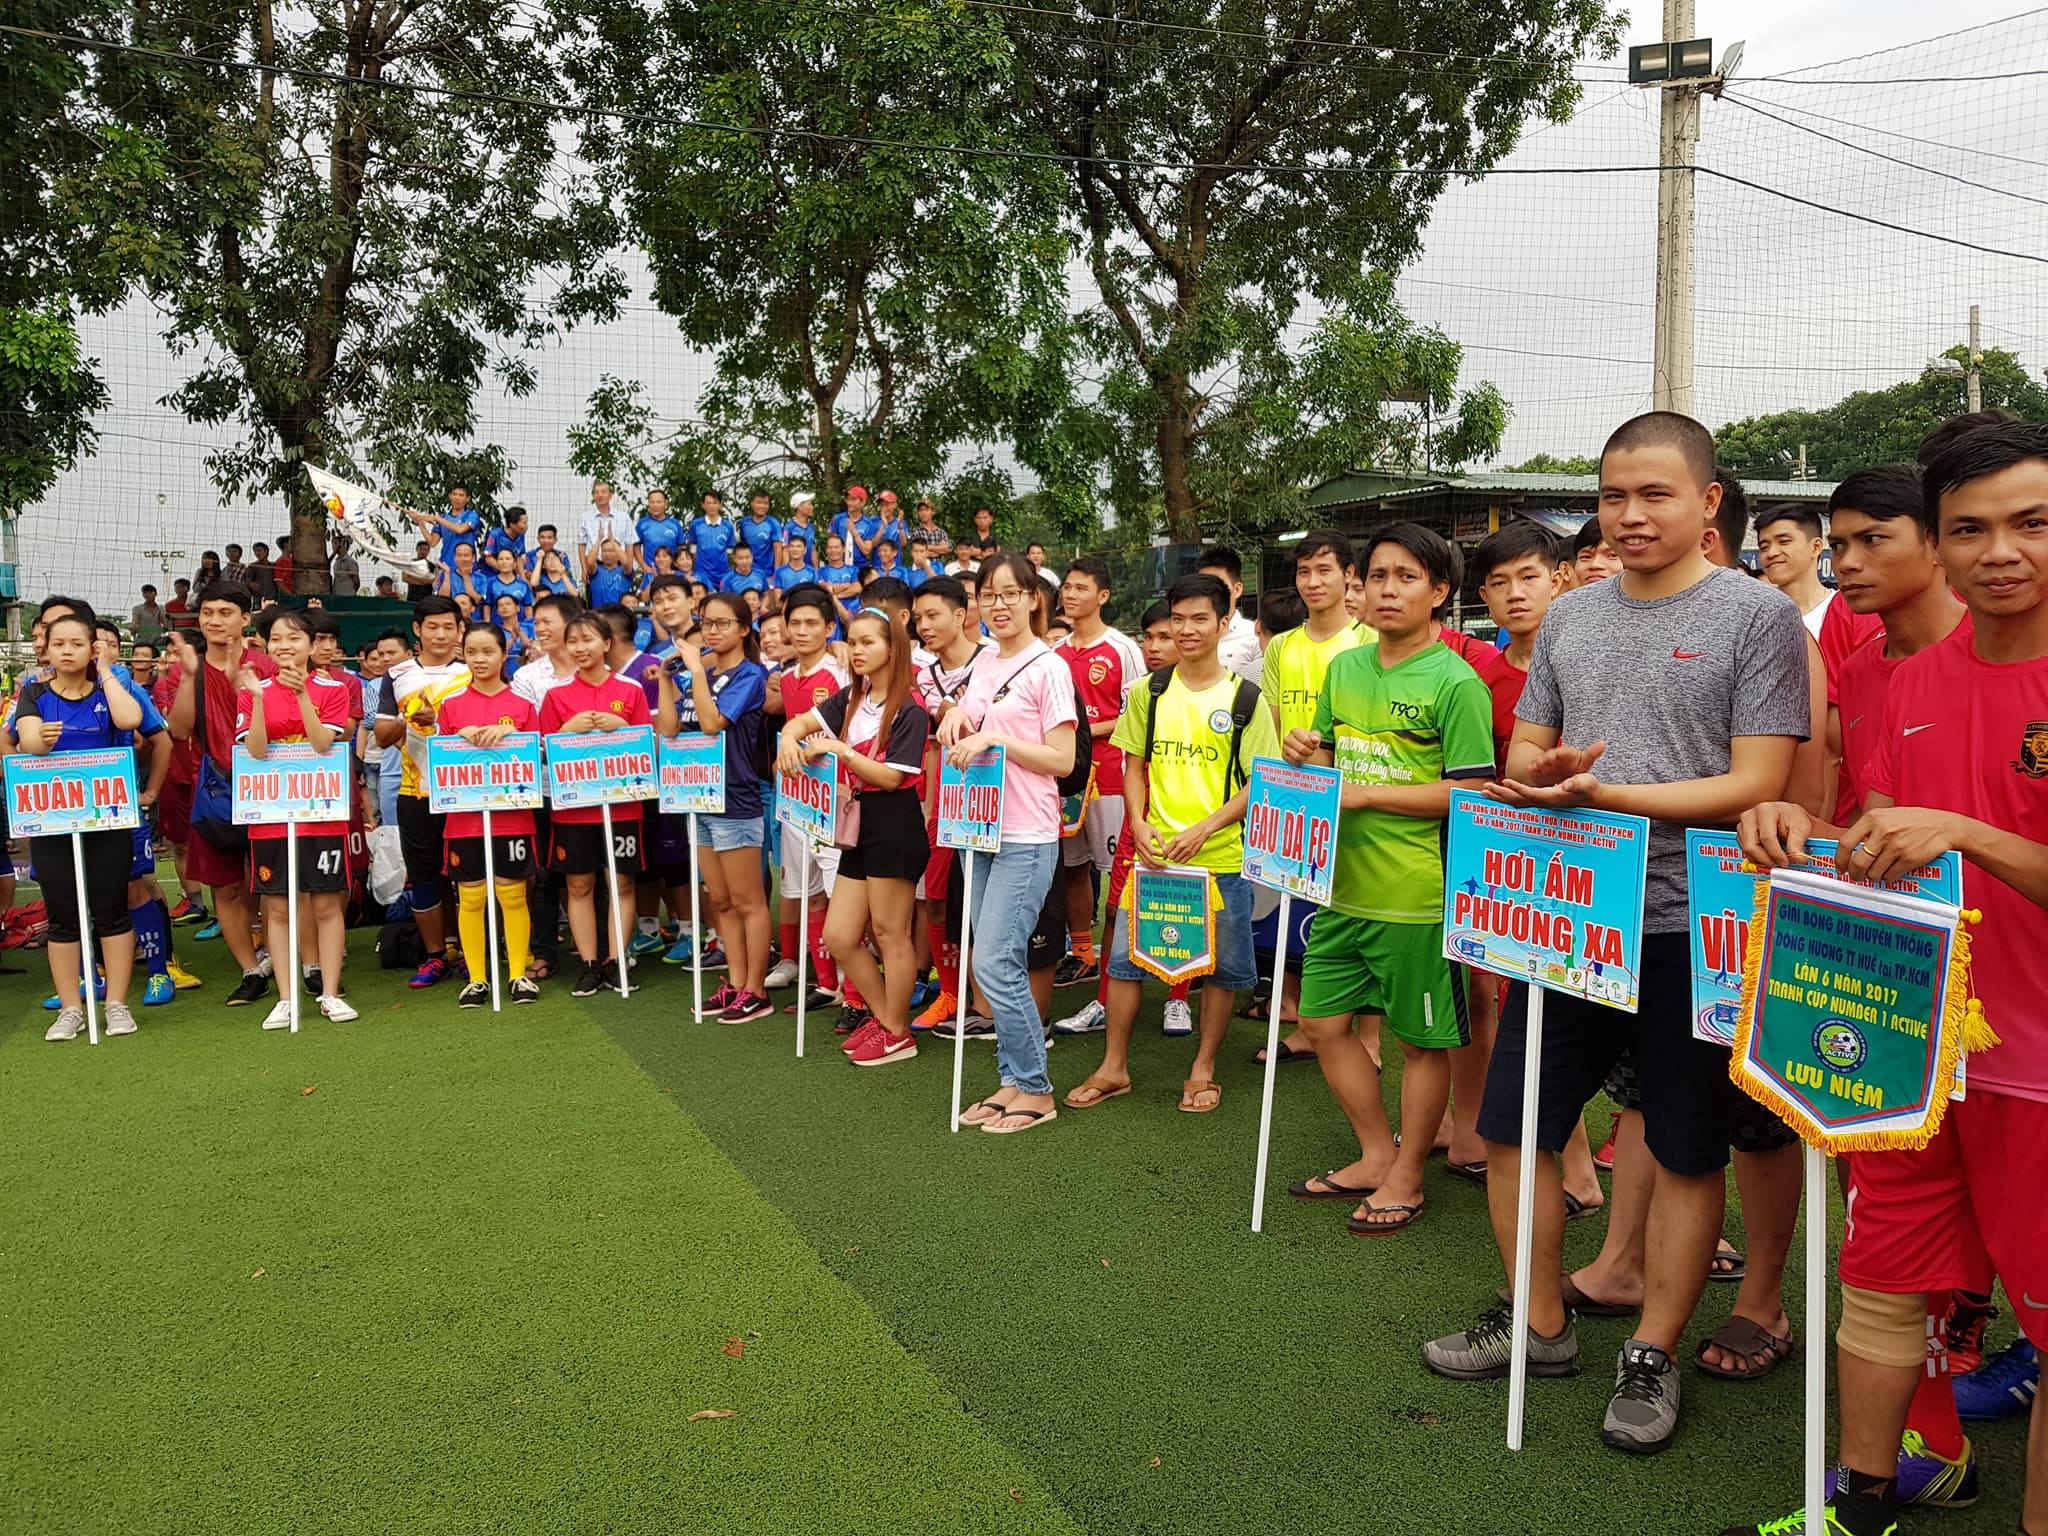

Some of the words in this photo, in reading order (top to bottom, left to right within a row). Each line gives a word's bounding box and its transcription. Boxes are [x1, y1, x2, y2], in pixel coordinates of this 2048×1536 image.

[1282, 689, 1320, 704] ETIH
[1391, 701, 1419, 720] T90
[1152, 740, 1218, 761] ETIHAD
[436, 765, 483, 787] VINH
[555, 759, 598, 783] VINH
[604, 753, 651, 778] HƯNG
[711, 765, 721, 784] FC
[16, 777, 84, 812] XUÂN
[239, 769, 279, 801] PHÚ
[288, 768, 340, 799] XUÂN
[968, 786, 999, 822] CLUB
[614, 834, 636, 858] 28
[1107, 835, 1116, 856] 6
[1308, 817, 1329, 869] FC
[1506, 821, 1520, 832] 2017
[1558, 831, 1585, 843] NUMBER
[1592, 837, 1617, 849] ACTIVE
[144, 839, 152, 860] 6
[317, 849, 341, 875] 47
[508, 839, 526, 862] 16
[1485, 849, 1534, 893] HƠI
[1544, 851, 1593, 906] ẤM
[1885, 880, 1918, 892] ACTIVE
[1455, 892, 1573, 953] PHƯƠNG
[1584, 922, 1623, 967] XA
[1822, 970, 1830, 986] 6
[1866, 982, 1898, 1006] 2017
[1895, 963, 1931, 988] TP.HCM
[1768, 979, 1804, 1003] TRANH
[1830, 996, 1878, 1025] NUMBER
[1882, 1010, 1887, 1027] 1
[1891, 1014, 1928, 1040] ACTIVE
[1826, 1049, 1856, 1059] ACTIVE
[1829, 1074, 1883, 1110] NIỆM
